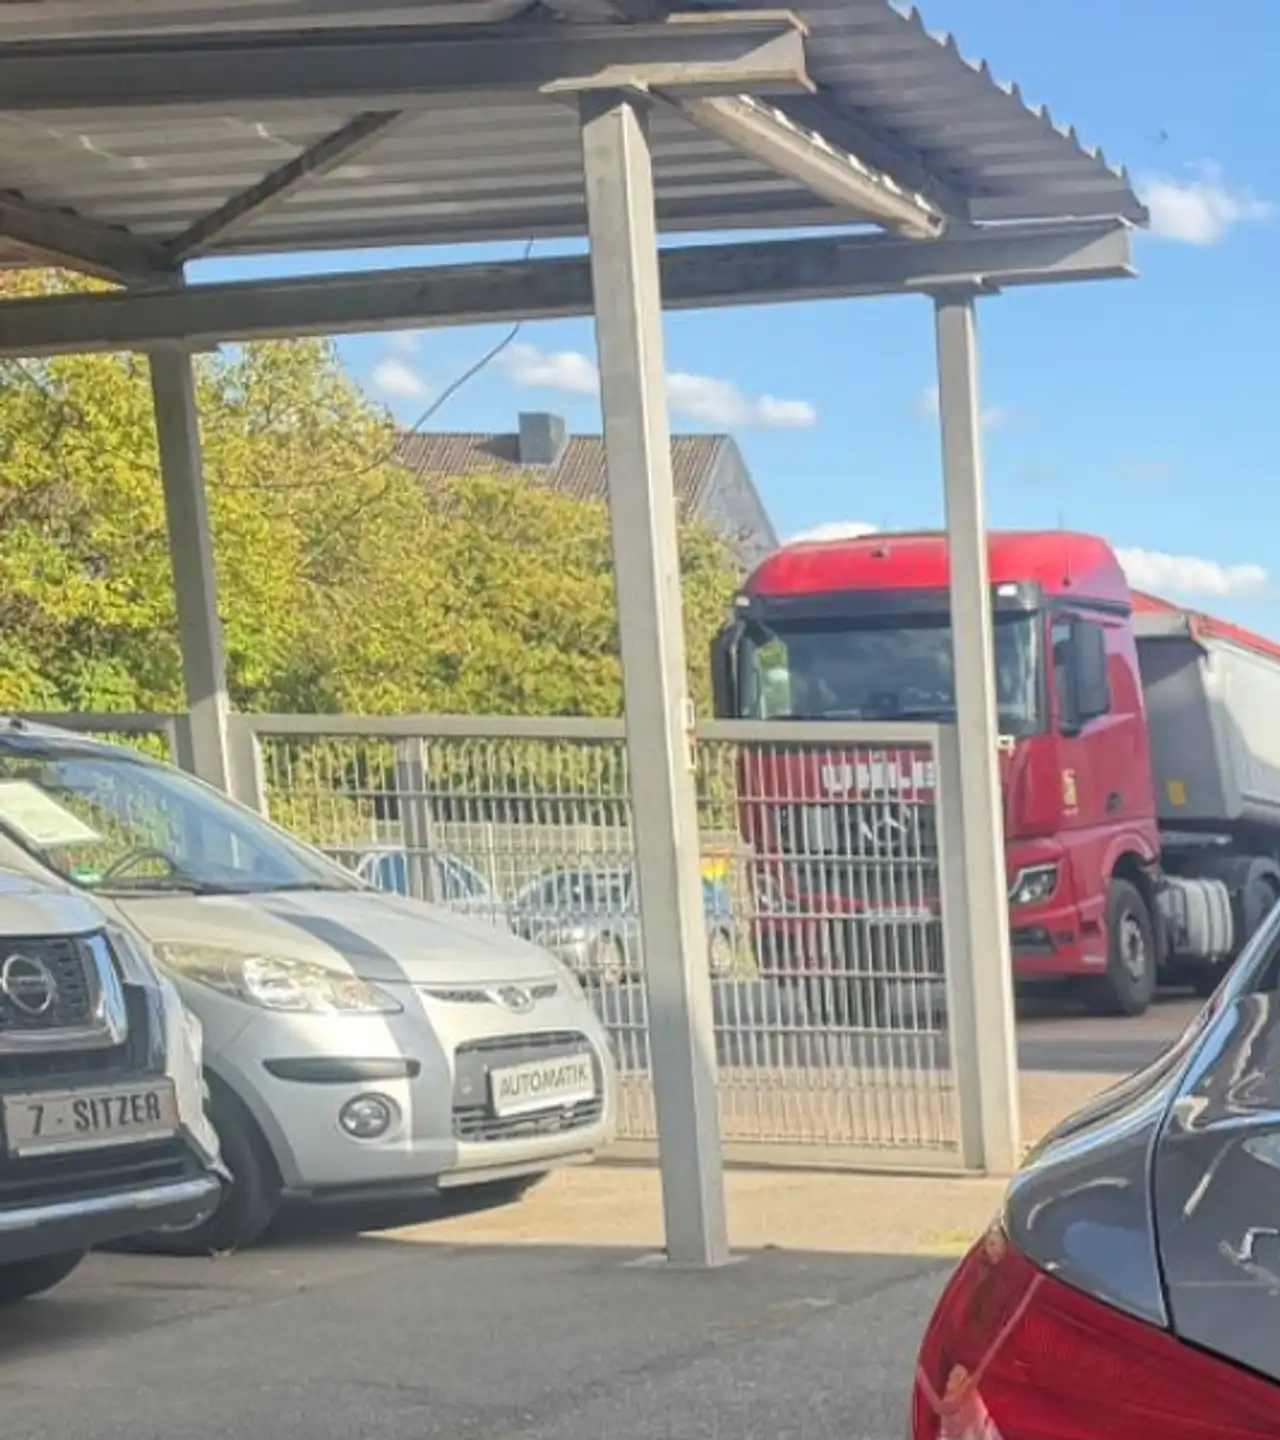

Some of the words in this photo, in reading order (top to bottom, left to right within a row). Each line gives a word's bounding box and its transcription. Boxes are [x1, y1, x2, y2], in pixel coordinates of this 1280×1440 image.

[500, 1064, 588, 1096] AUTOMATIK
[27, 1104, 44, 1136] 7
[73, 1092, 161, 1131] SITZER
